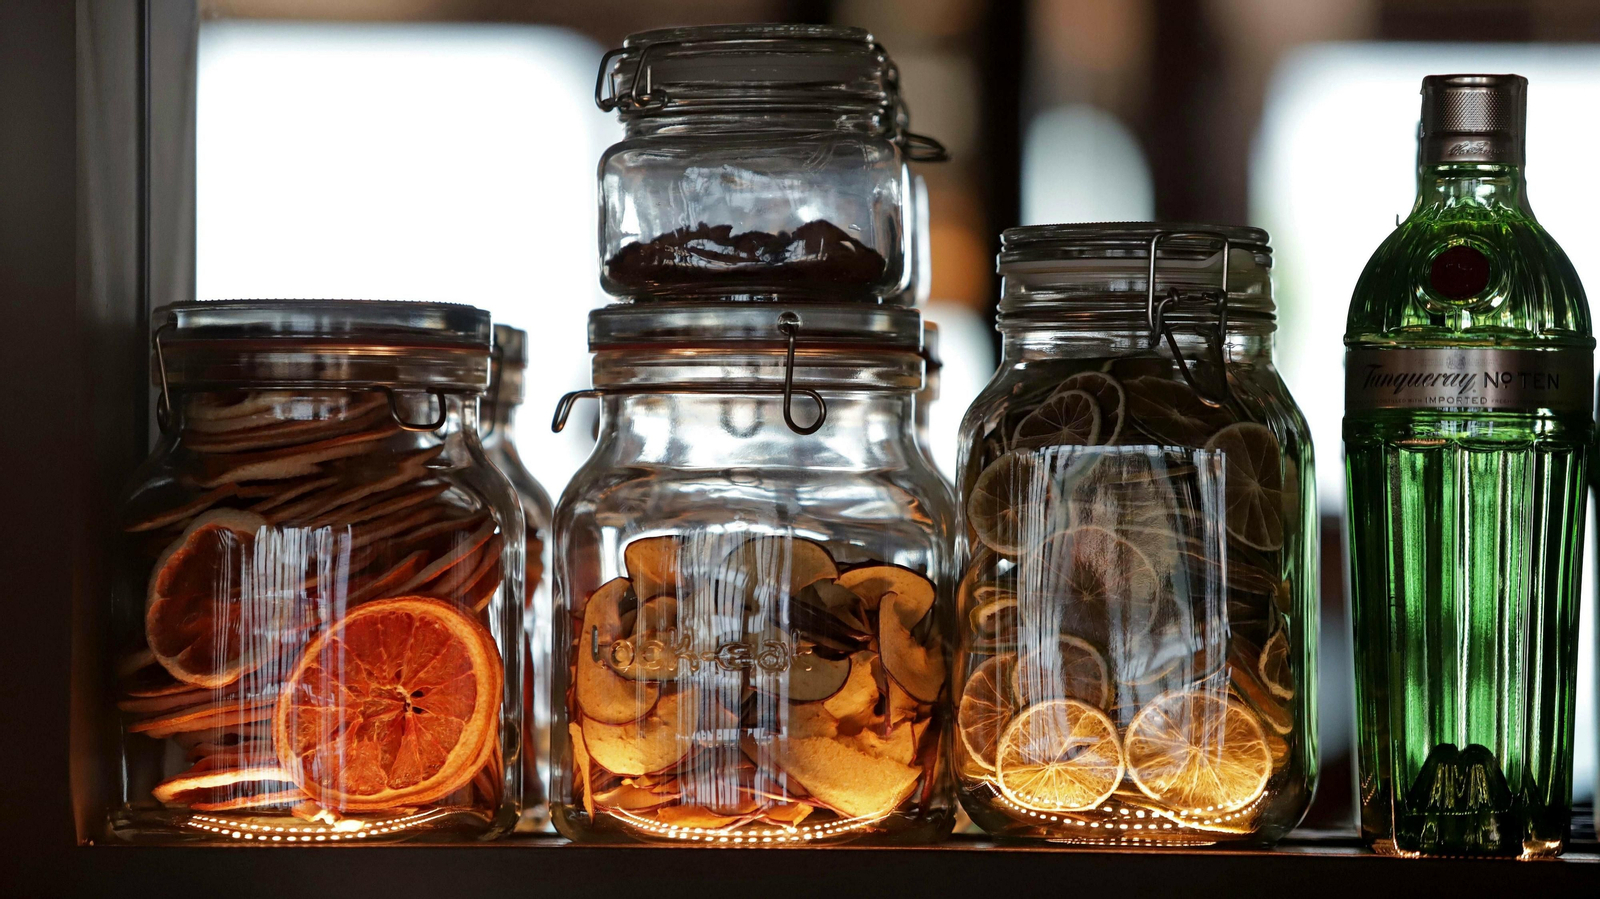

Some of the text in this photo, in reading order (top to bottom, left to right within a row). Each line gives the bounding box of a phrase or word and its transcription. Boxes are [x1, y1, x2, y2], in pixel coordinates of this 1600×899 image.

[1362, 363, 1477, 395] Tanqueray
[1517, 371, 1559, 389] TEN
[1425, 396, 1488, 405] IMPORTED
